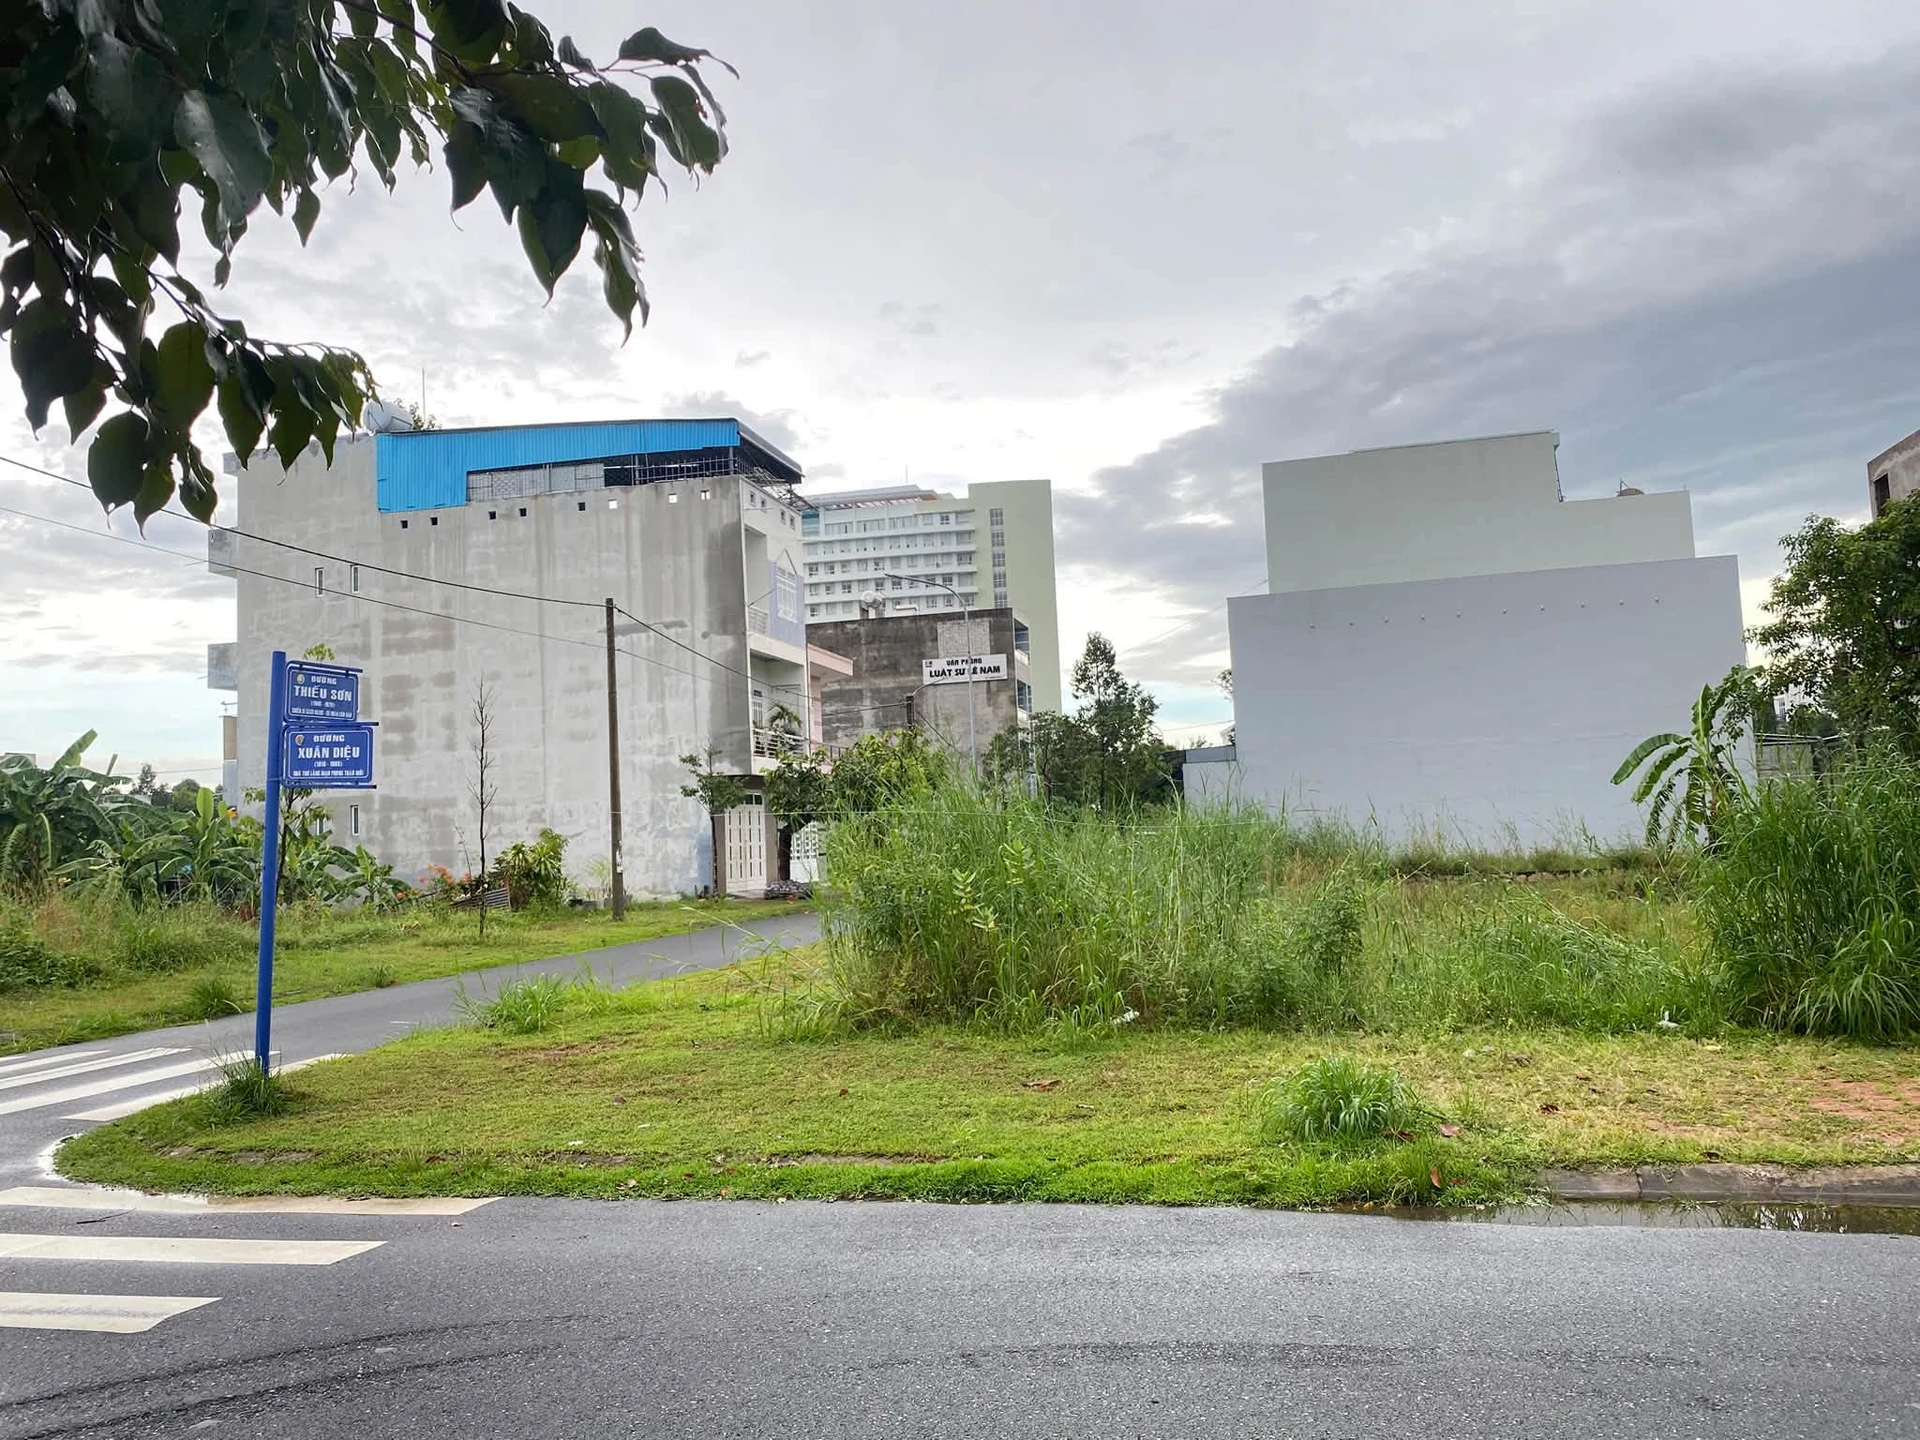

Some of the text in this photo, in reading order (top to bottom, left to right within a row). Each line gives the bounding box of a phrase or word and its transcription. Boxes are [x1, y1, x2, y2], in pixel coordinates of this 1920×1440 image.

[960, 657, 982, 666] PNG
[979, 665, 1001, 675] NAM
[330, 689, 352, 701] SƠN
[333, 745, 360, 760] DIỆU
